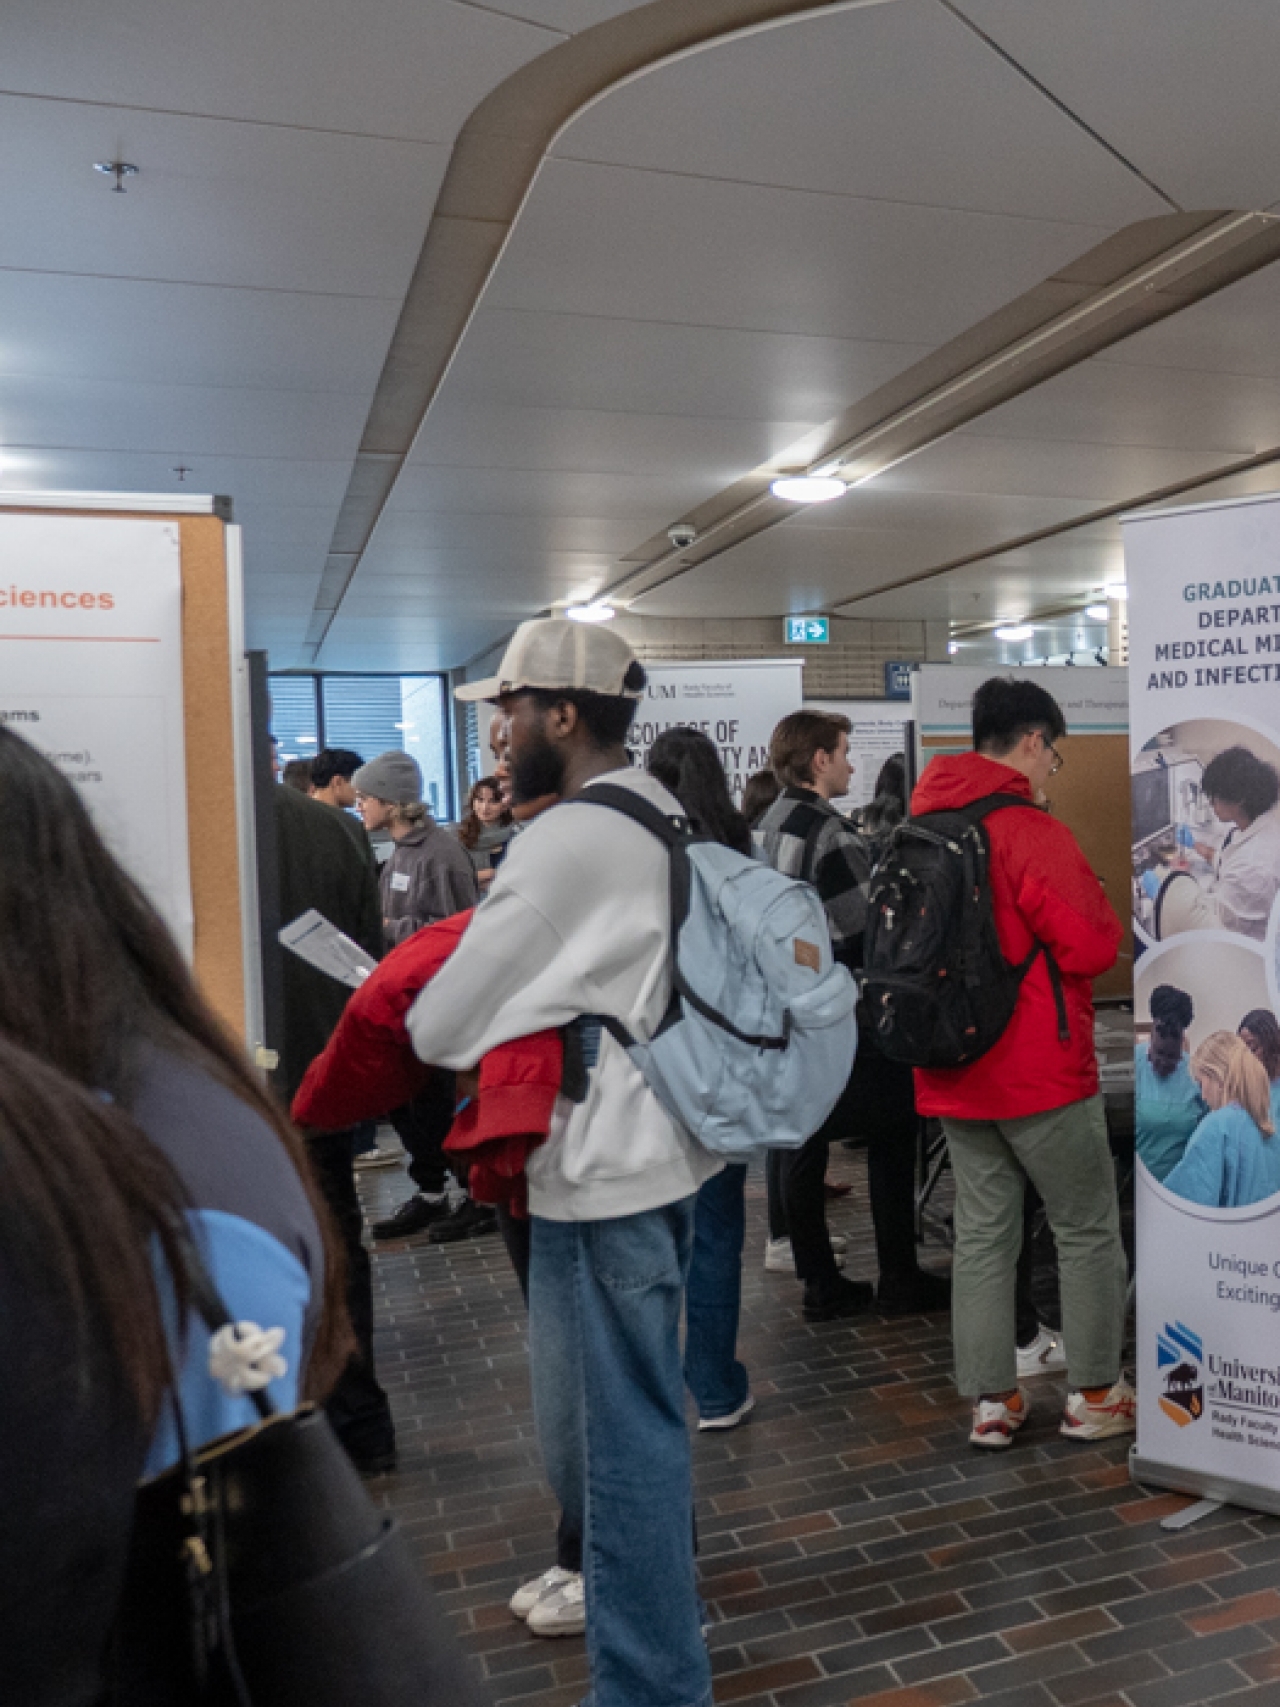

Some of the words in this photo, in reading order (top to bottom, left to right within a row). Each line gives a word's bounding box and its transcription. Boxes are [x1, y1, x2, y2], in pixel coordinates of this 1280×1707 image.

[1155, 637, 1249, 662] MEDICAL
[1147, 670, 1189, 691] AND
[648, 685, 676, 699] UM
[716, 720, 740, 743] OF
[1208, 1251, 1268, 1279] Unique
[1216, 1280, 1280, 1312] Exciting
[1212, 1427, 1245, 1443] Health
[1240, 1414, 1279, 1436] Faculty
